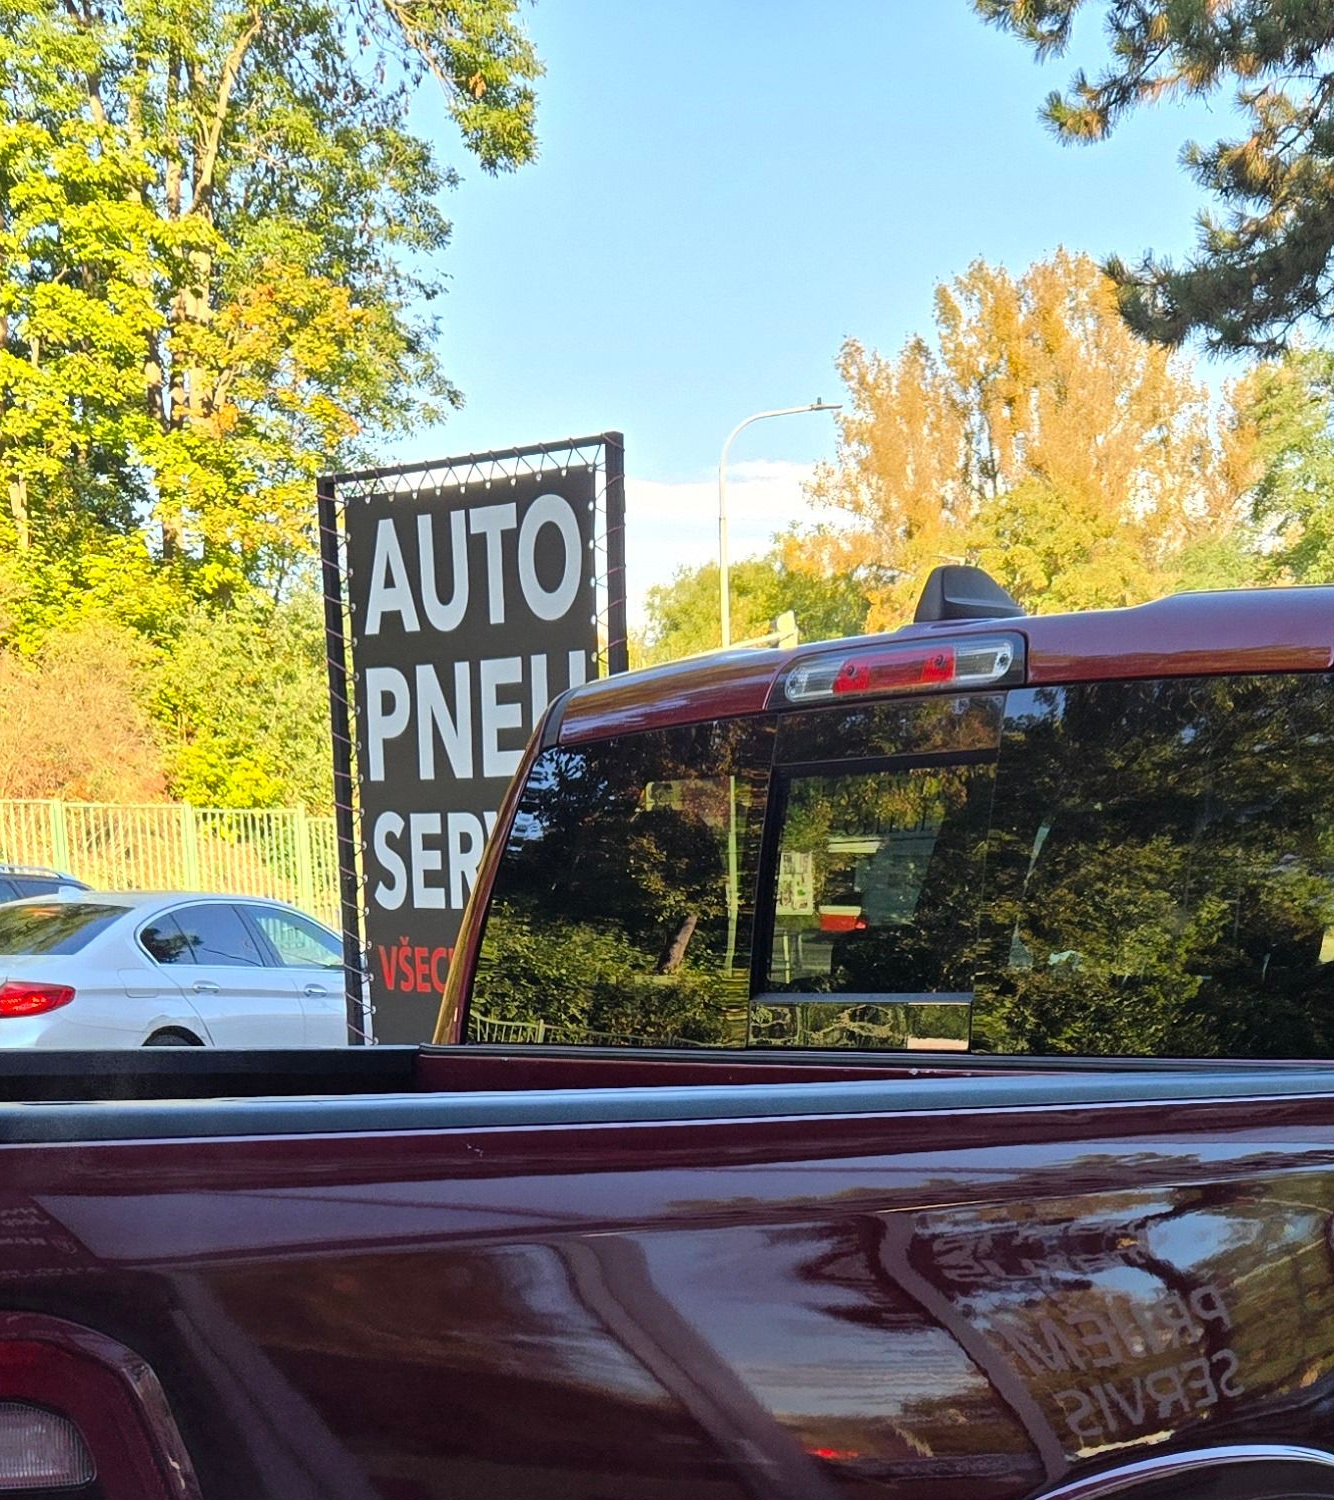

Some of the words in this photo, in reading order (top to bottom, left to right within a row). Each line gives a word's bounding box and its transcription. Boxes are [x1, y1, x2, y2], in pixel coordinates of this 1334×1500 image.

[364, 494, 582, 635] AUTO
[373, 809, 498, 910] SER
[378, 936, 454, 993] VŠEC
